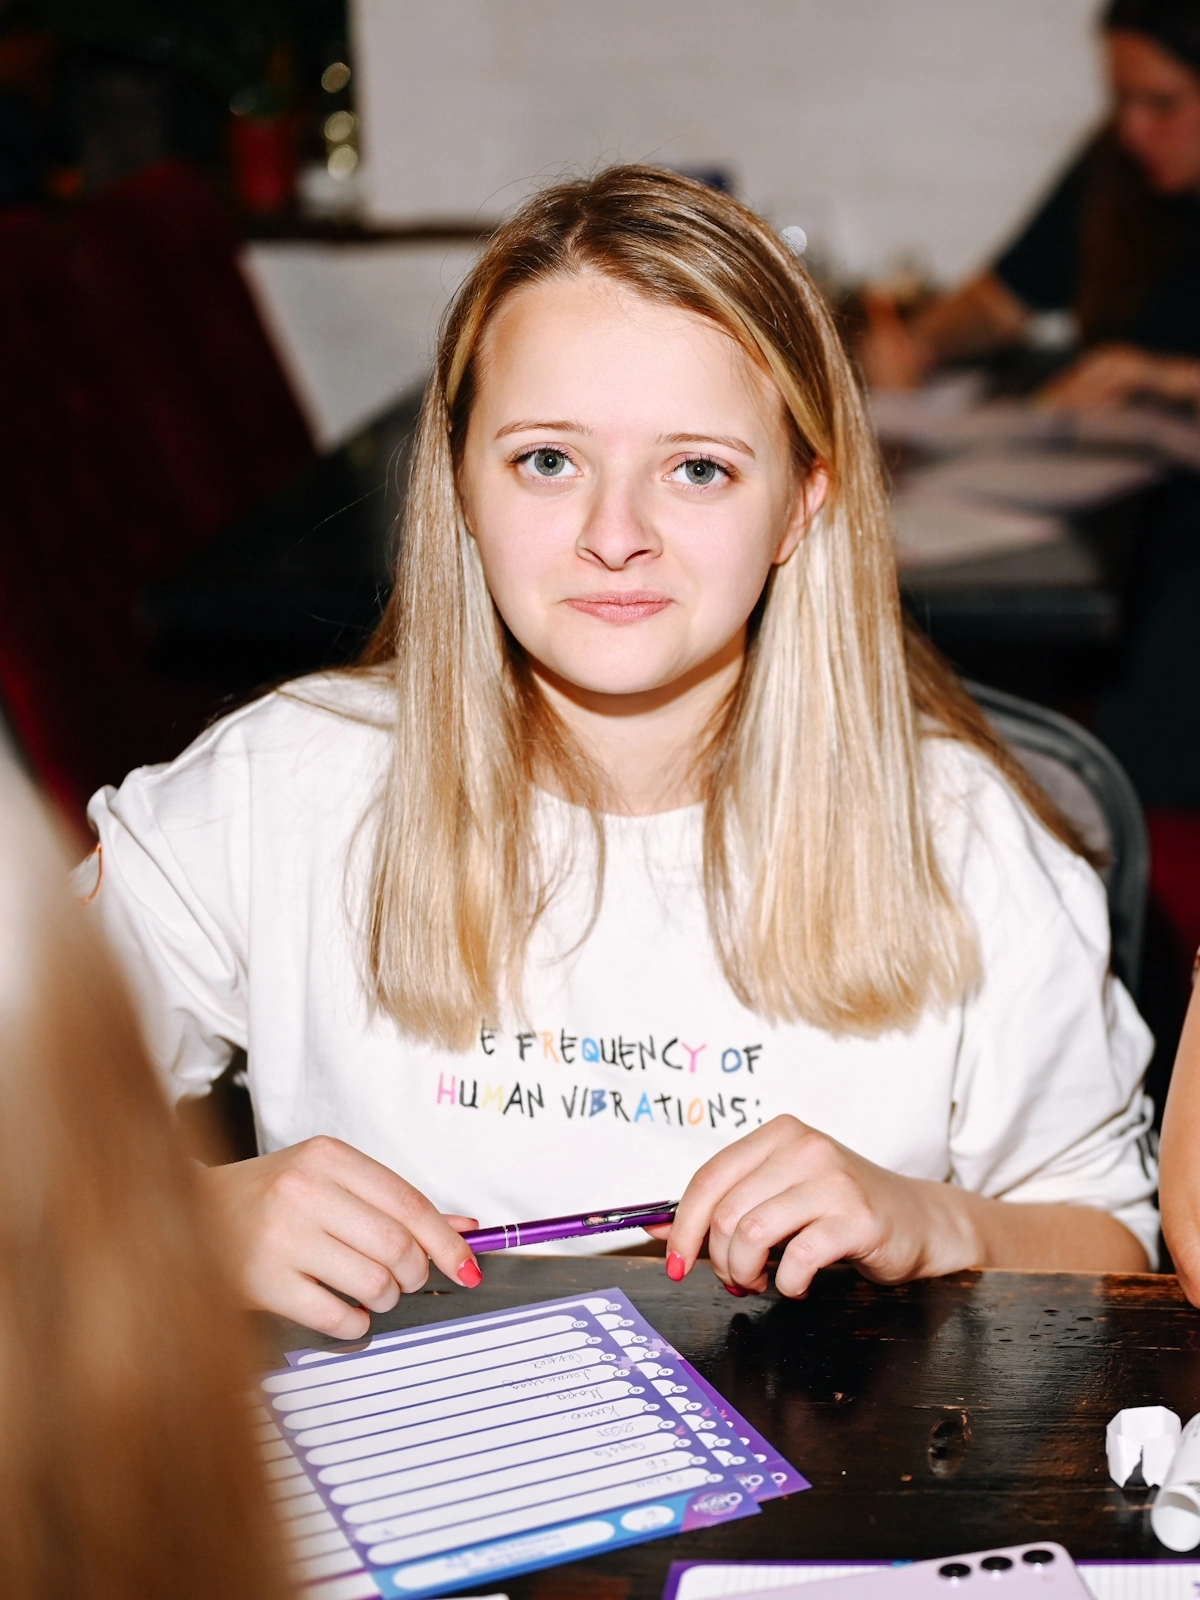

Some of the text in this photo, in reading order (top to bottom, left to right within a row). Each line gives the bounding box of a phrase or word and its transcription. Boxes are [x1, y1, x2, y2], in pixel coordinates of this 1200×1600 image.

[514, 1028, 707, 1074] FREQUENCY
[721, 1044, 763, 1074] OF
[436, 1072, 545, 1119] HUMAN
